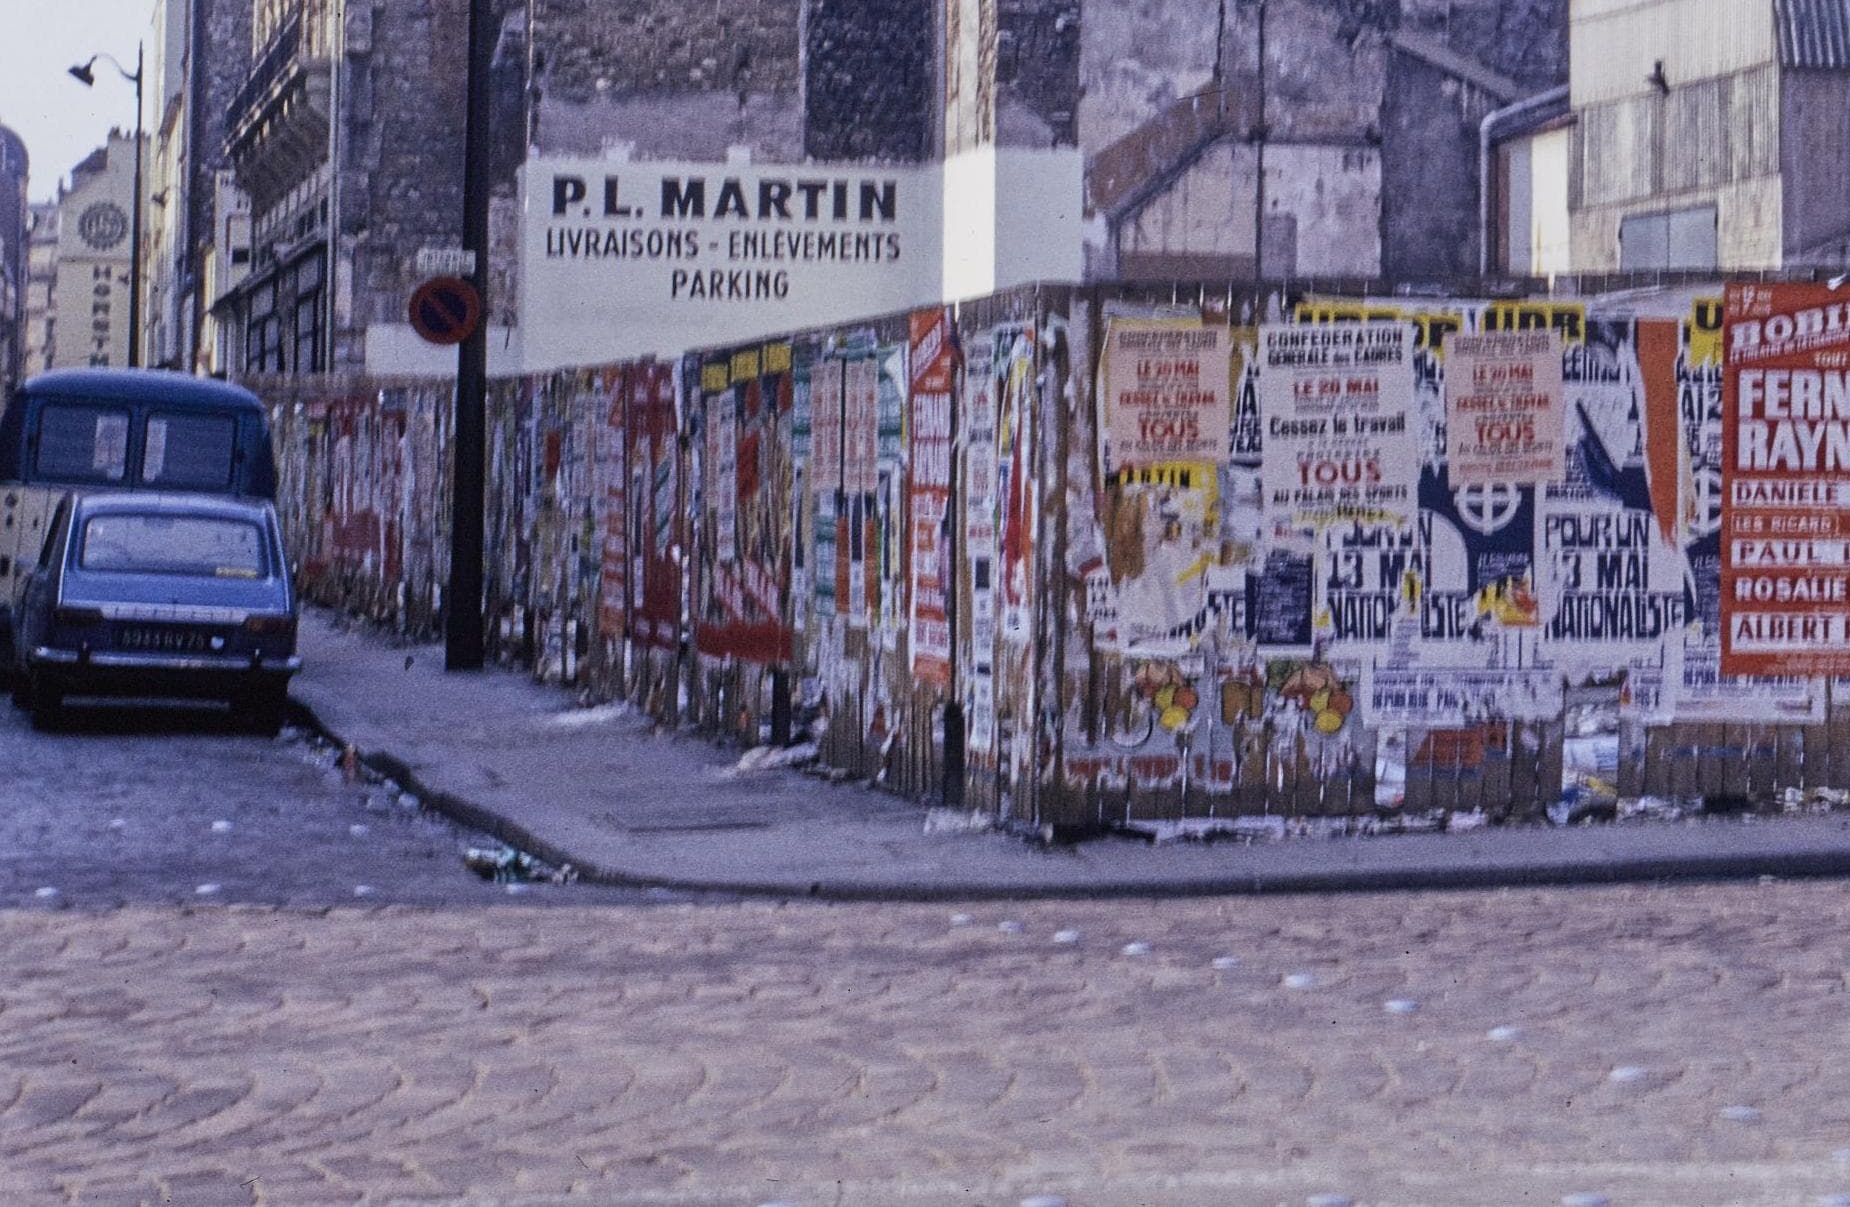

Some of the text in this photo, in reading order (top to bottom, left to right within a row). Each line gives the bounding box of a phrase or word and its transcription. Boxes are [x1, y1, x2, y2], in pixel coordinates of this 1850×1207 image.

[552, 173, 898, 222] P.L. MARTIN
[546, 227, 699, 260] LIVRAISONS
[671, 269, 790, 300] PARKING
[1267, 329, 1403, 348] CONFEDERATION
[1346, 377, 1380, 394] MAI
[1299, 460, 1382, 486] TOUS
[1546, 513, 1650, 548] POUR UN
[1740, 542, 1822, 564] PAUL
[1598, 552, 1650, 589] MAI
[1735, 577, 1847, 602] ROSALIE
[1737, 615, 1833, 641] ALBERT
